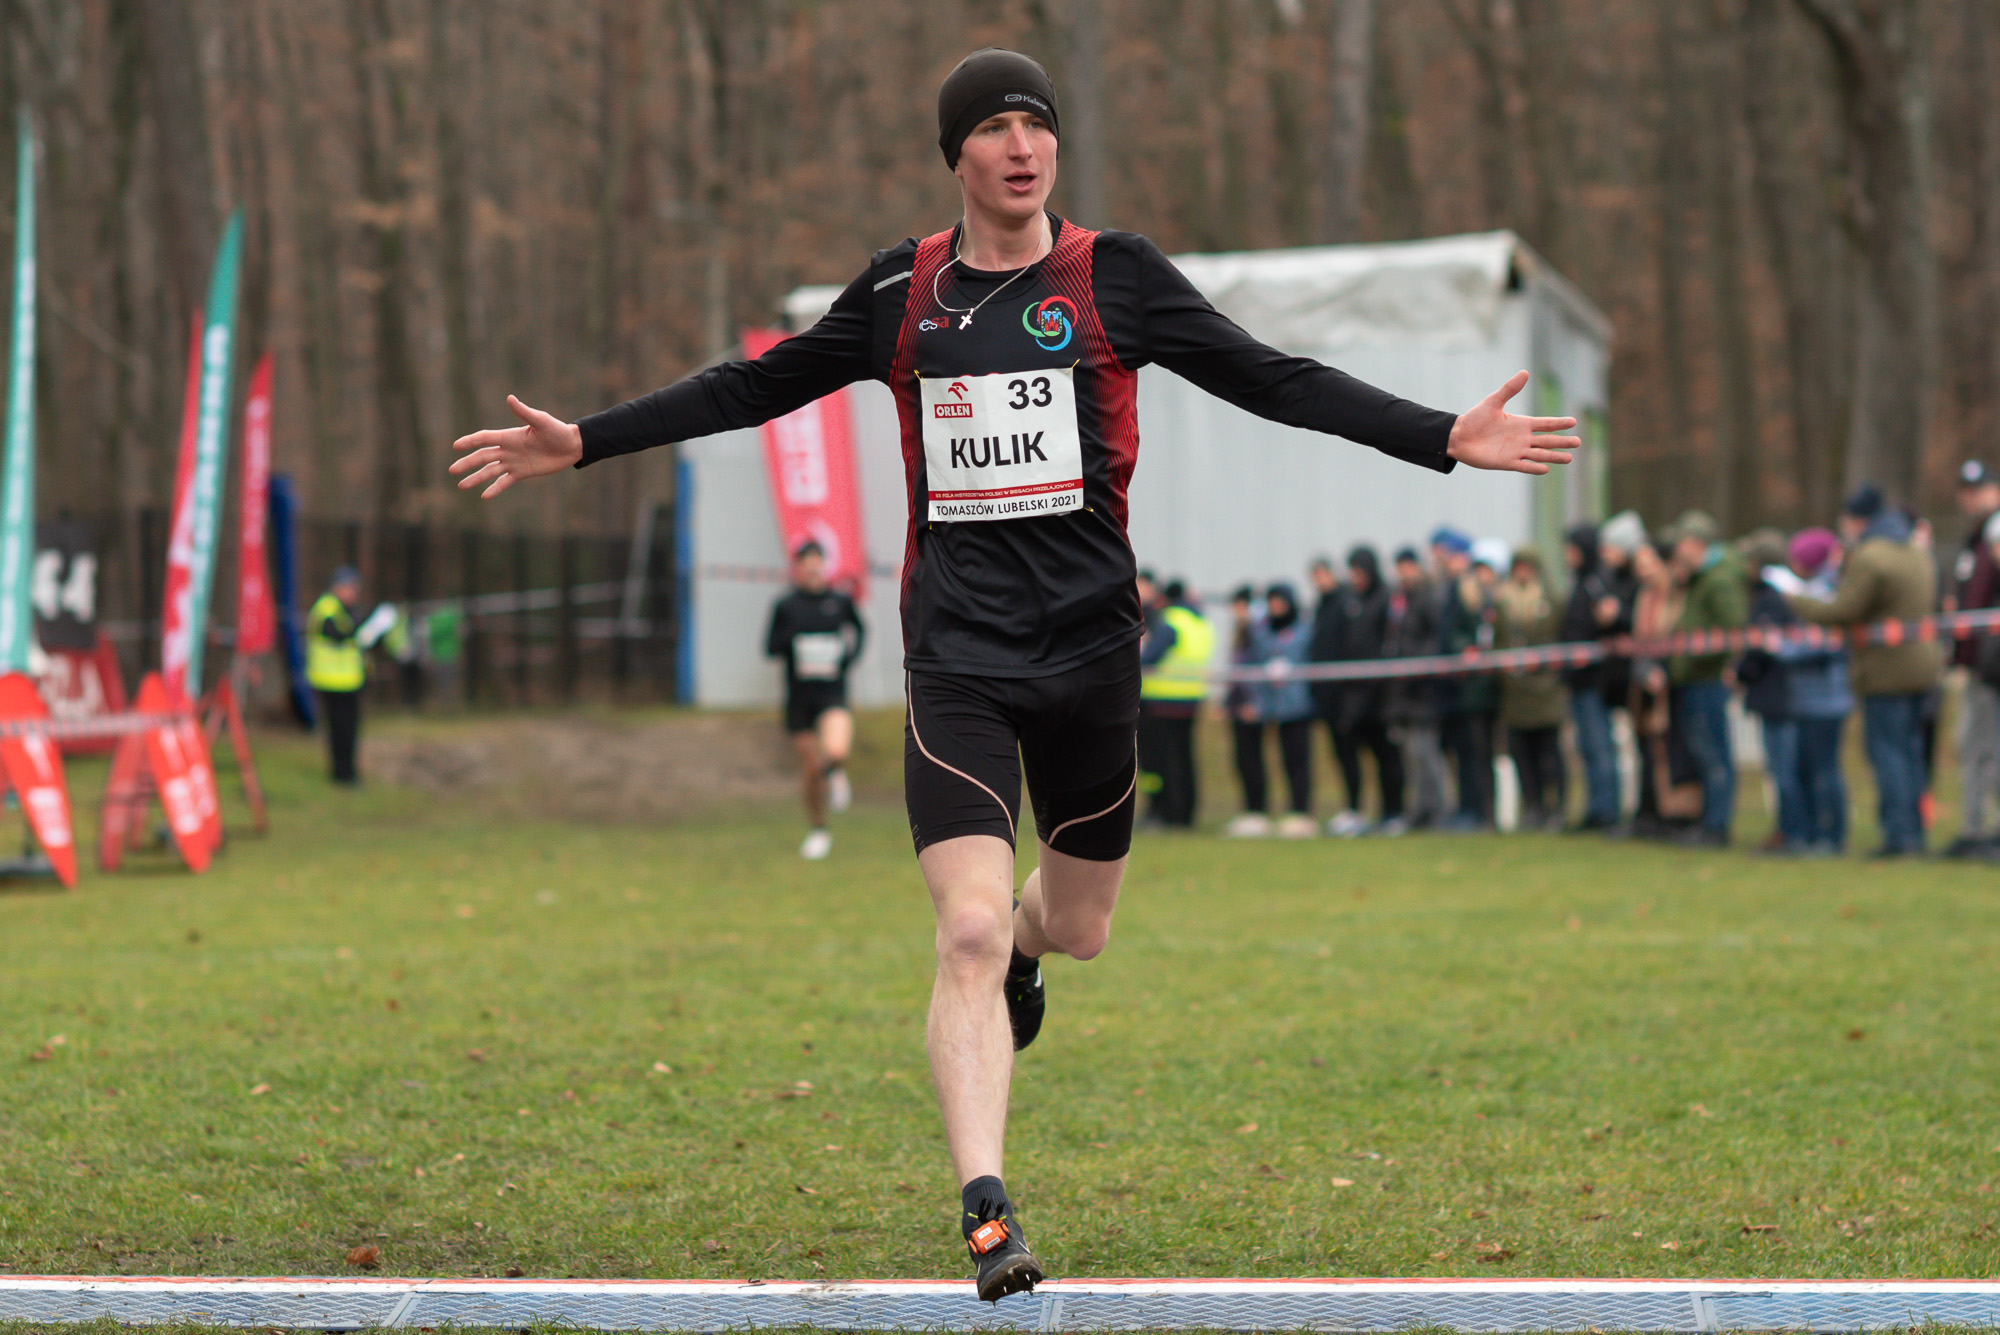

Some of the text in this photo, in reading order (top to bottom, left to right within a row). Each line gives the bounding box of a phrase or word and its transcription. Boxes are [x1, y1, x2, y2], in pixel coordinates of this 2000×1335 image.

[1007, 376, 1053, 410] 33
[936, 405, 971, 418] ORLEN
[950, 431, 1048, 469] KULIK
[985, 490, 1004, 498] POLSKI
[1010, 487, 1033, 495] BIEGACH
[936, 494, 1077, 516] TOMASZÓW LUBELSKI 2021
